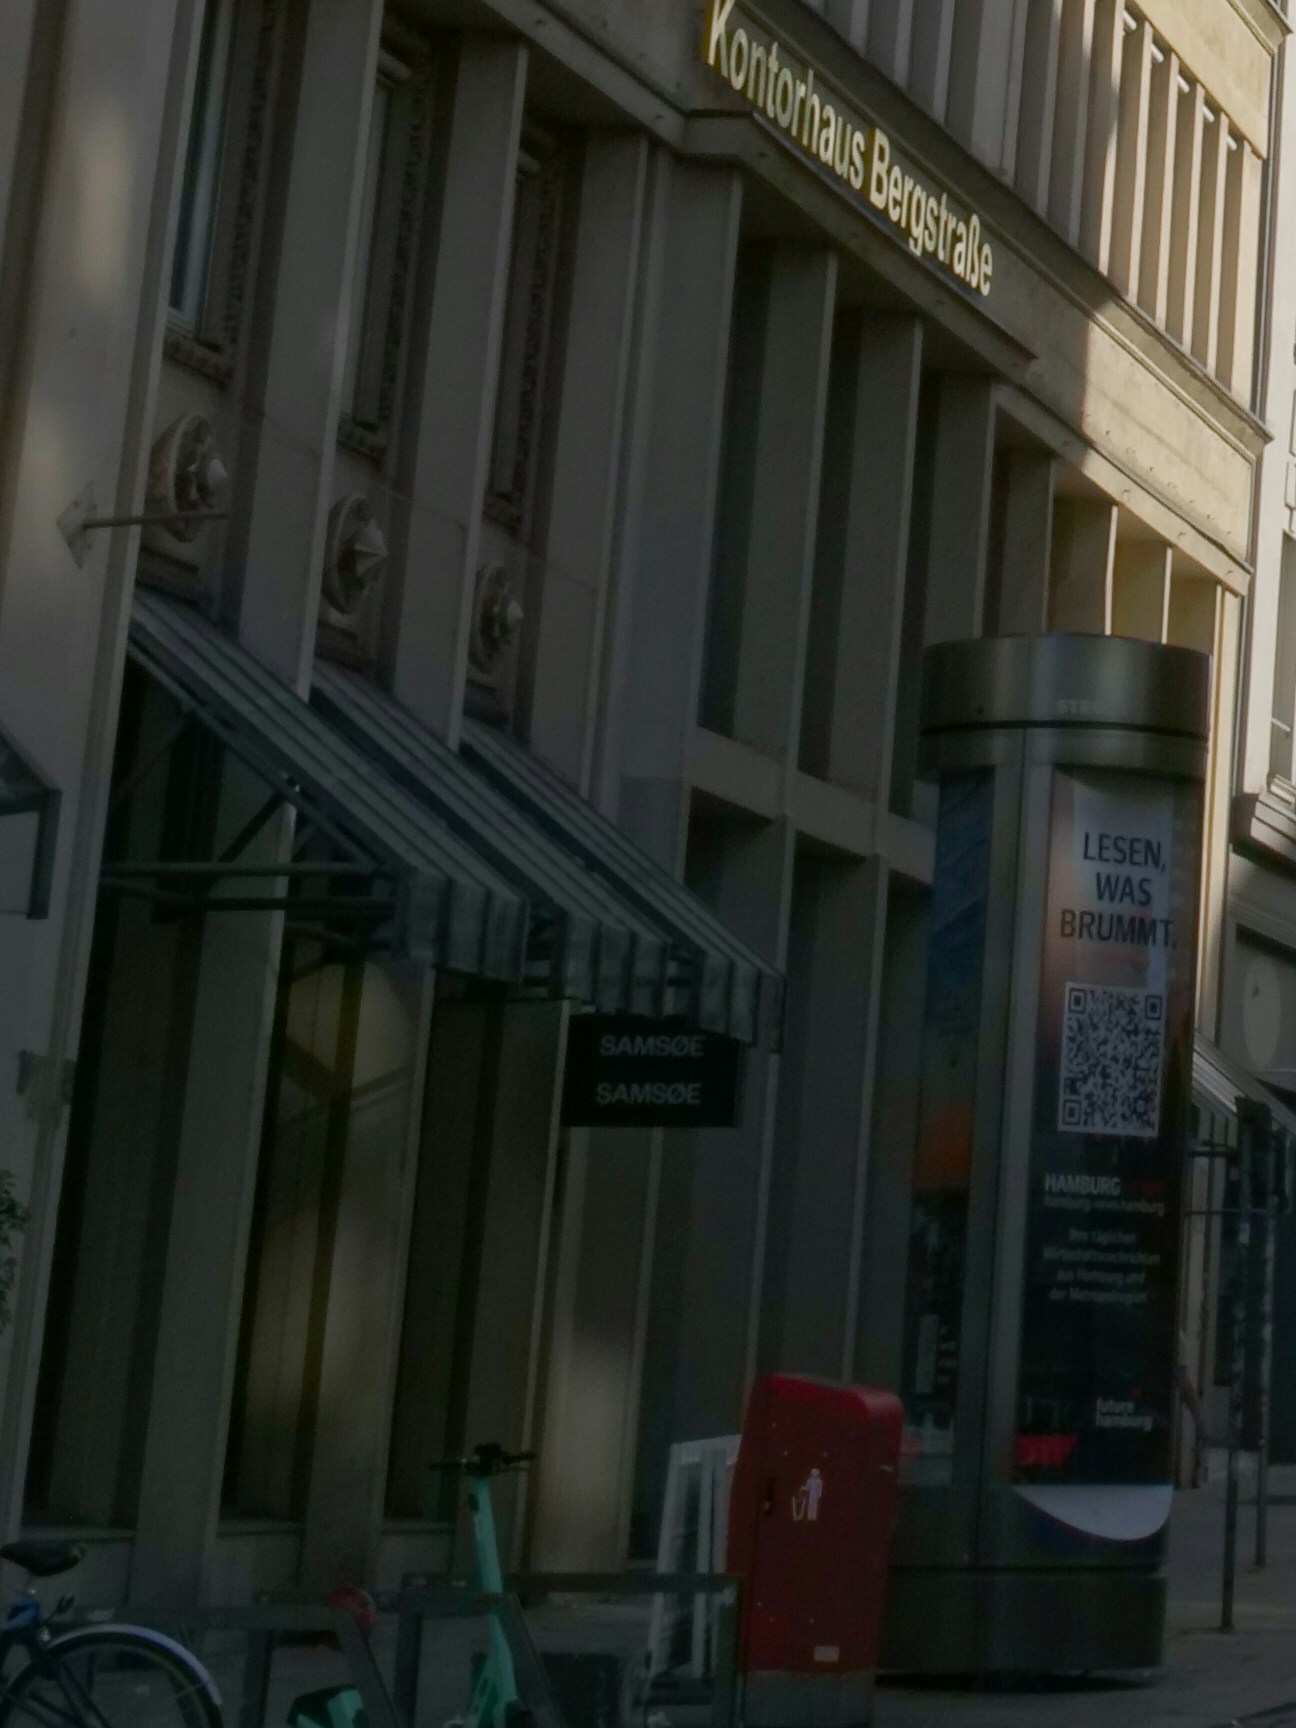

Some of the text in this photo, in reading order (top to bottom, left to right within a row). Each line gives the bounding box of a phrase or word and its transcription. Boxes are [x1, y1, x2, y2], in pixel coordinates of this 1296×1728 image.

[868, 127, 993, 296] Bergstraße
[1083, 831, 1166, 873] LESEN,
[1096, 872, 1152, 906] WAS
[1060, 908, 1176, 950] BRUMMT.
[600, 1034, 706, 1057] SAMSØE
[596, 1081, 702, 1105] SAMSØE
[1044, 1173, 1121, 1196] HAMBURG
